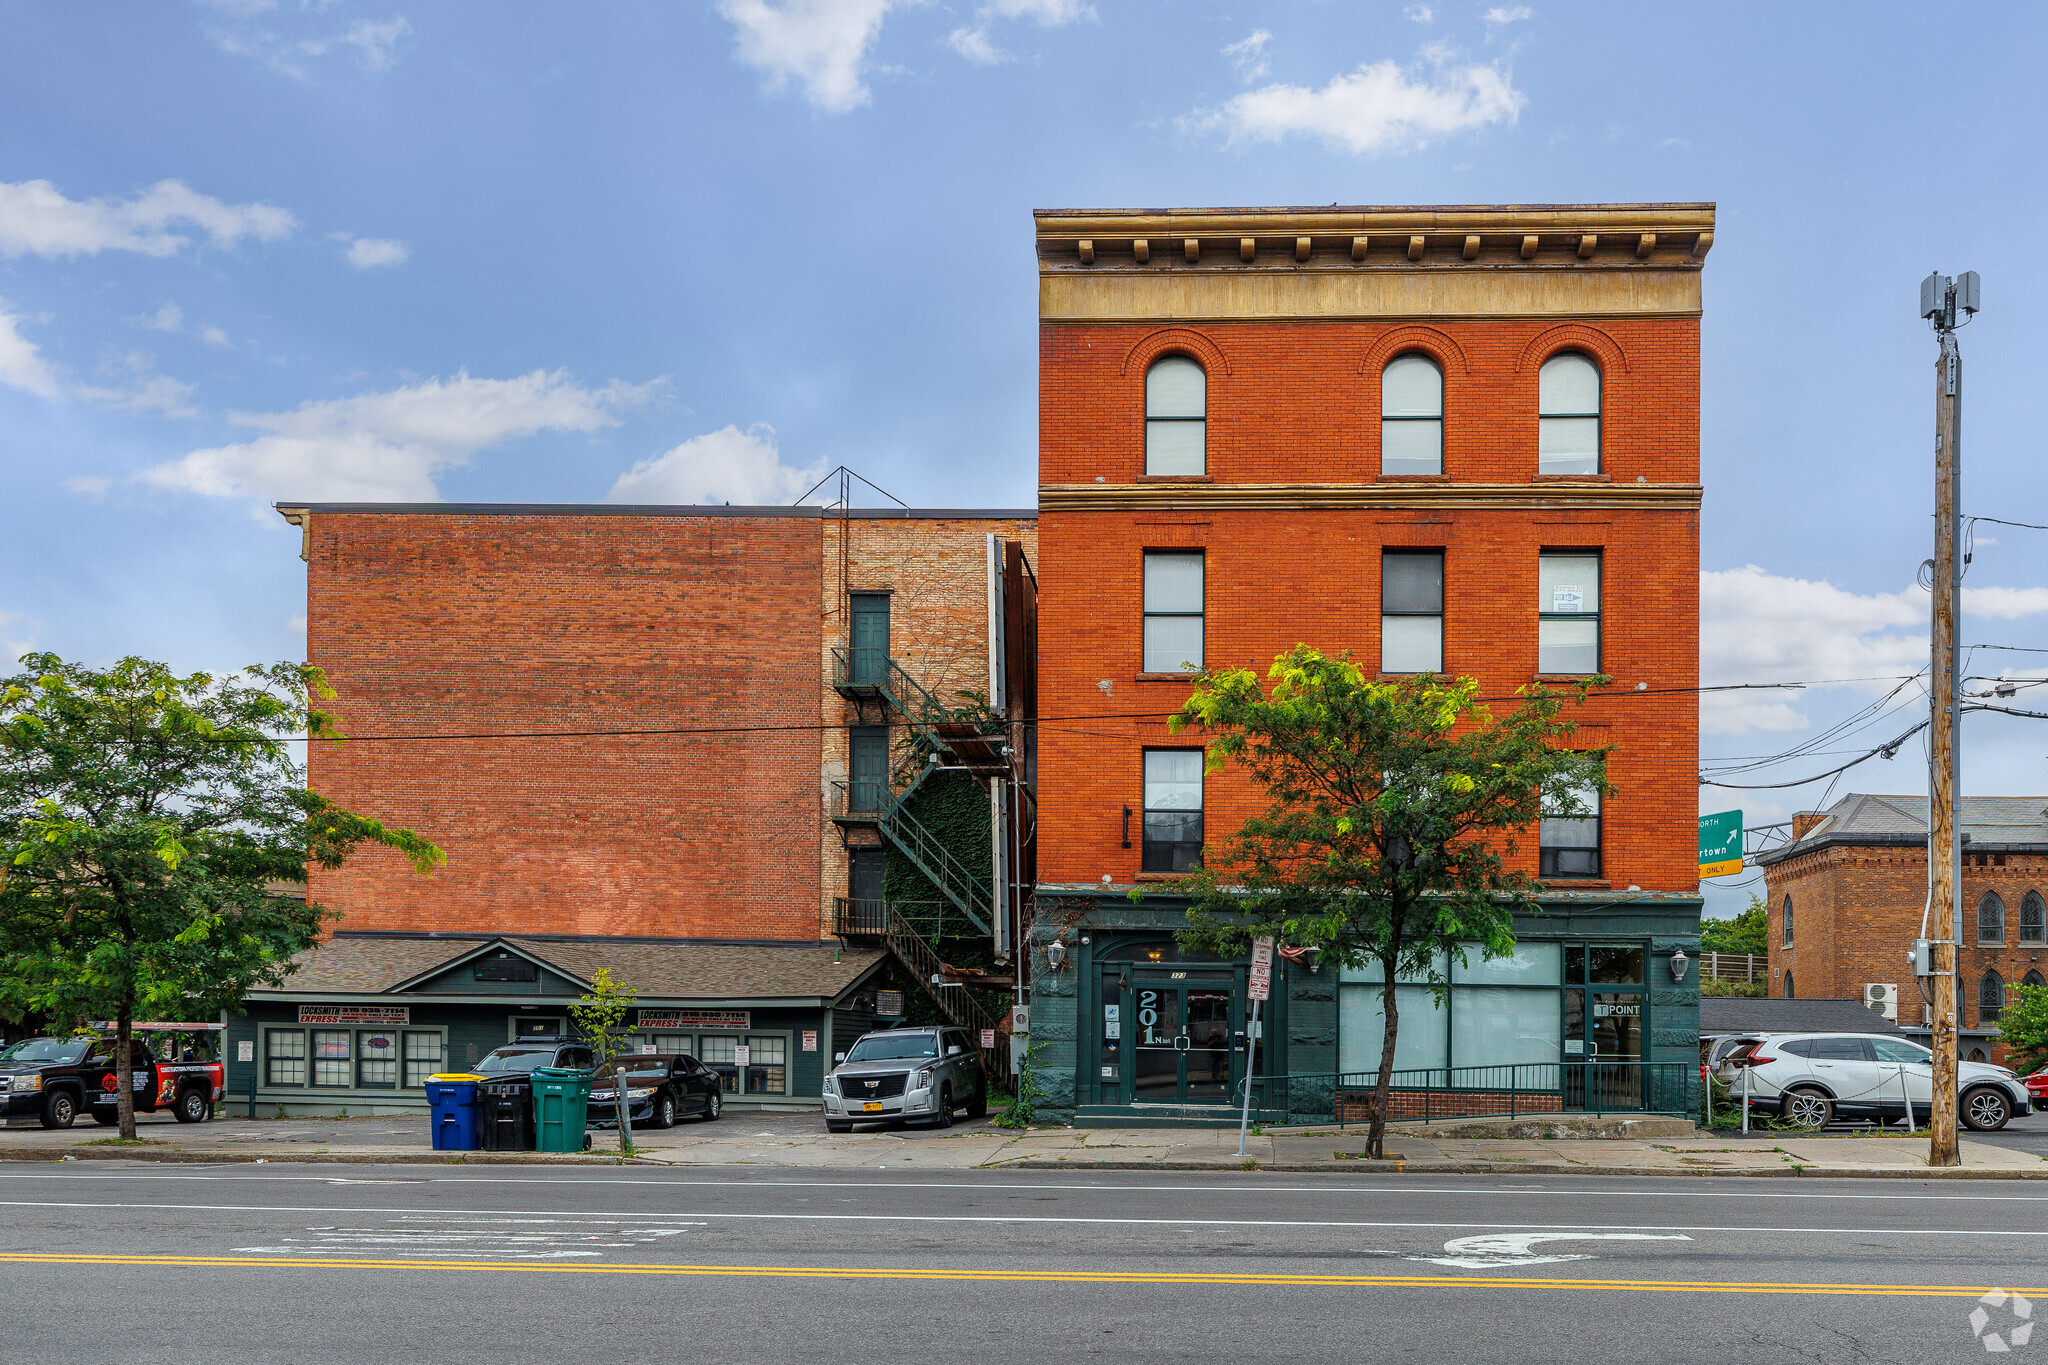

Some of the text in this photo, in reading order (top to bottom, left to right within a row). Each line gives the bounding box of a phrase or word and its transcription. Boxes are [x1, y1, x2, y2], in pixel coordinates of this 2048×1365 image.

[1699, 818, 1719, 828] ORTH
[1700, 847, 1726, 857] rtown
[1707, 866, 1725, 874] ONLY
[300, 1006, 340, 1015] LOCKSMITH
[1609, 1006, 1640, 1014] POINT
[640, 1011, 680, 1019] LOCKSMITH
